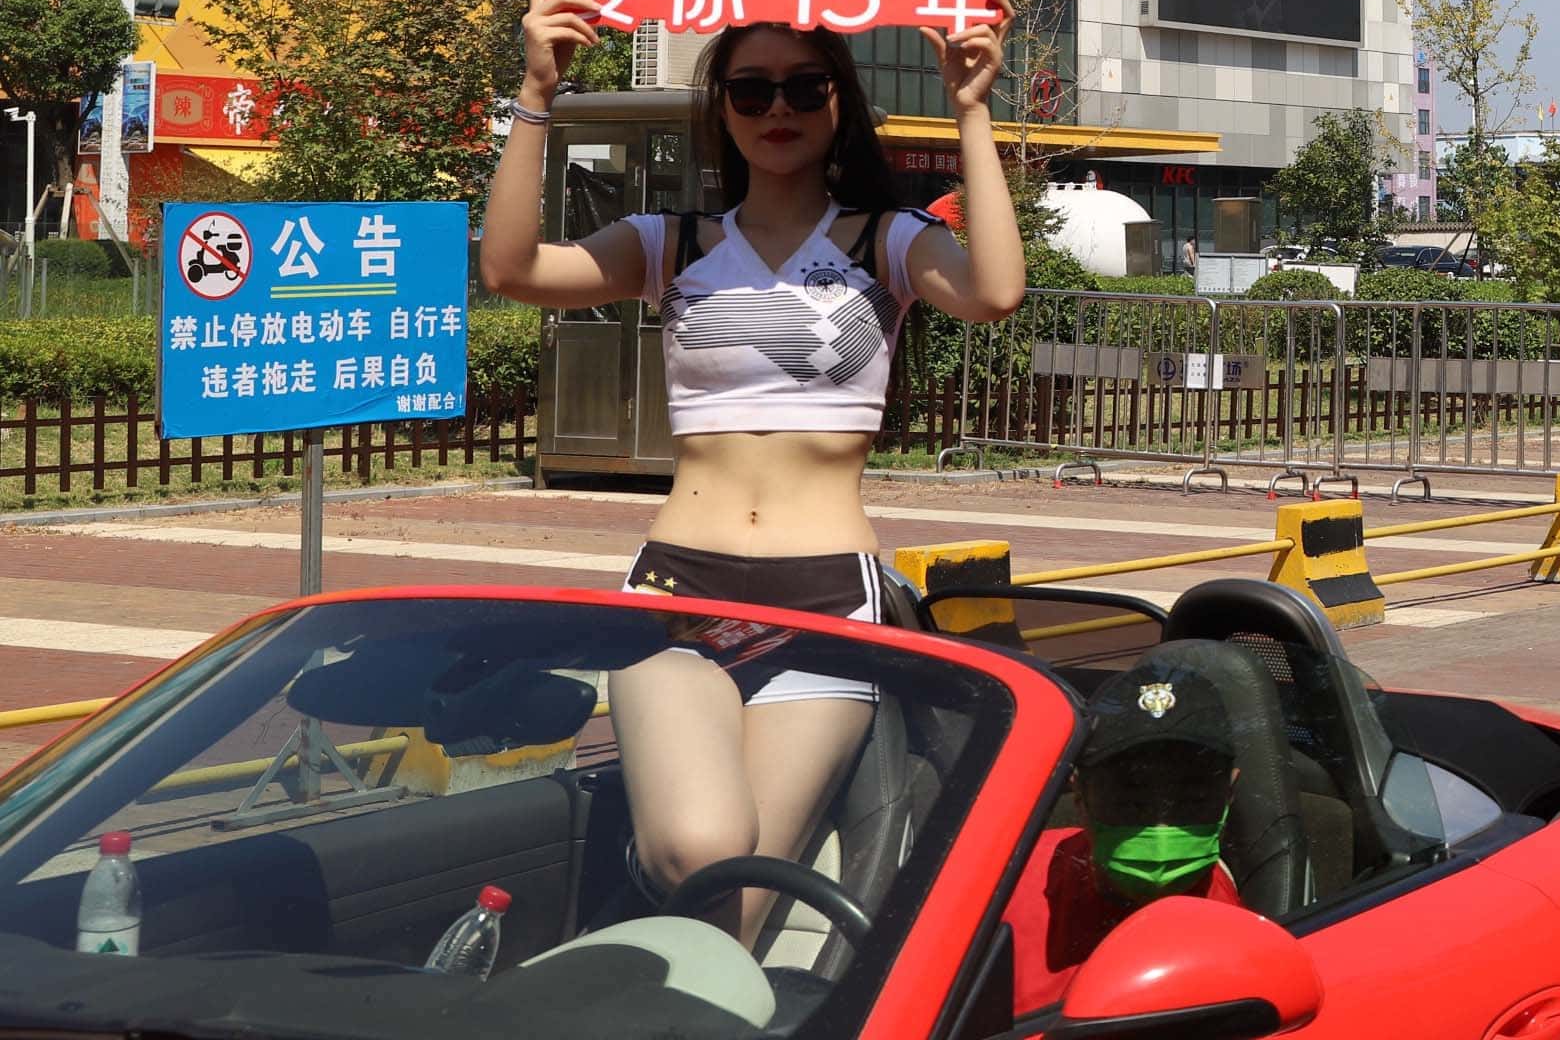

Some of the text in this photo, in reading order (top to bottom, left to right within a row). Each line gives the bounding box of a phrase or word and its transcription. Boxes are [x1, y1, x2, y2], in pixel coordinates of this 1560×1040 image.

[1162, 166, 1197, 185] KFC
[270, 214, 401, 279] 公告
[169, 305, 462, 351] 禁止停放电动车 自行车
[201, 352, 438, 400] 违者拖走 后果自负
